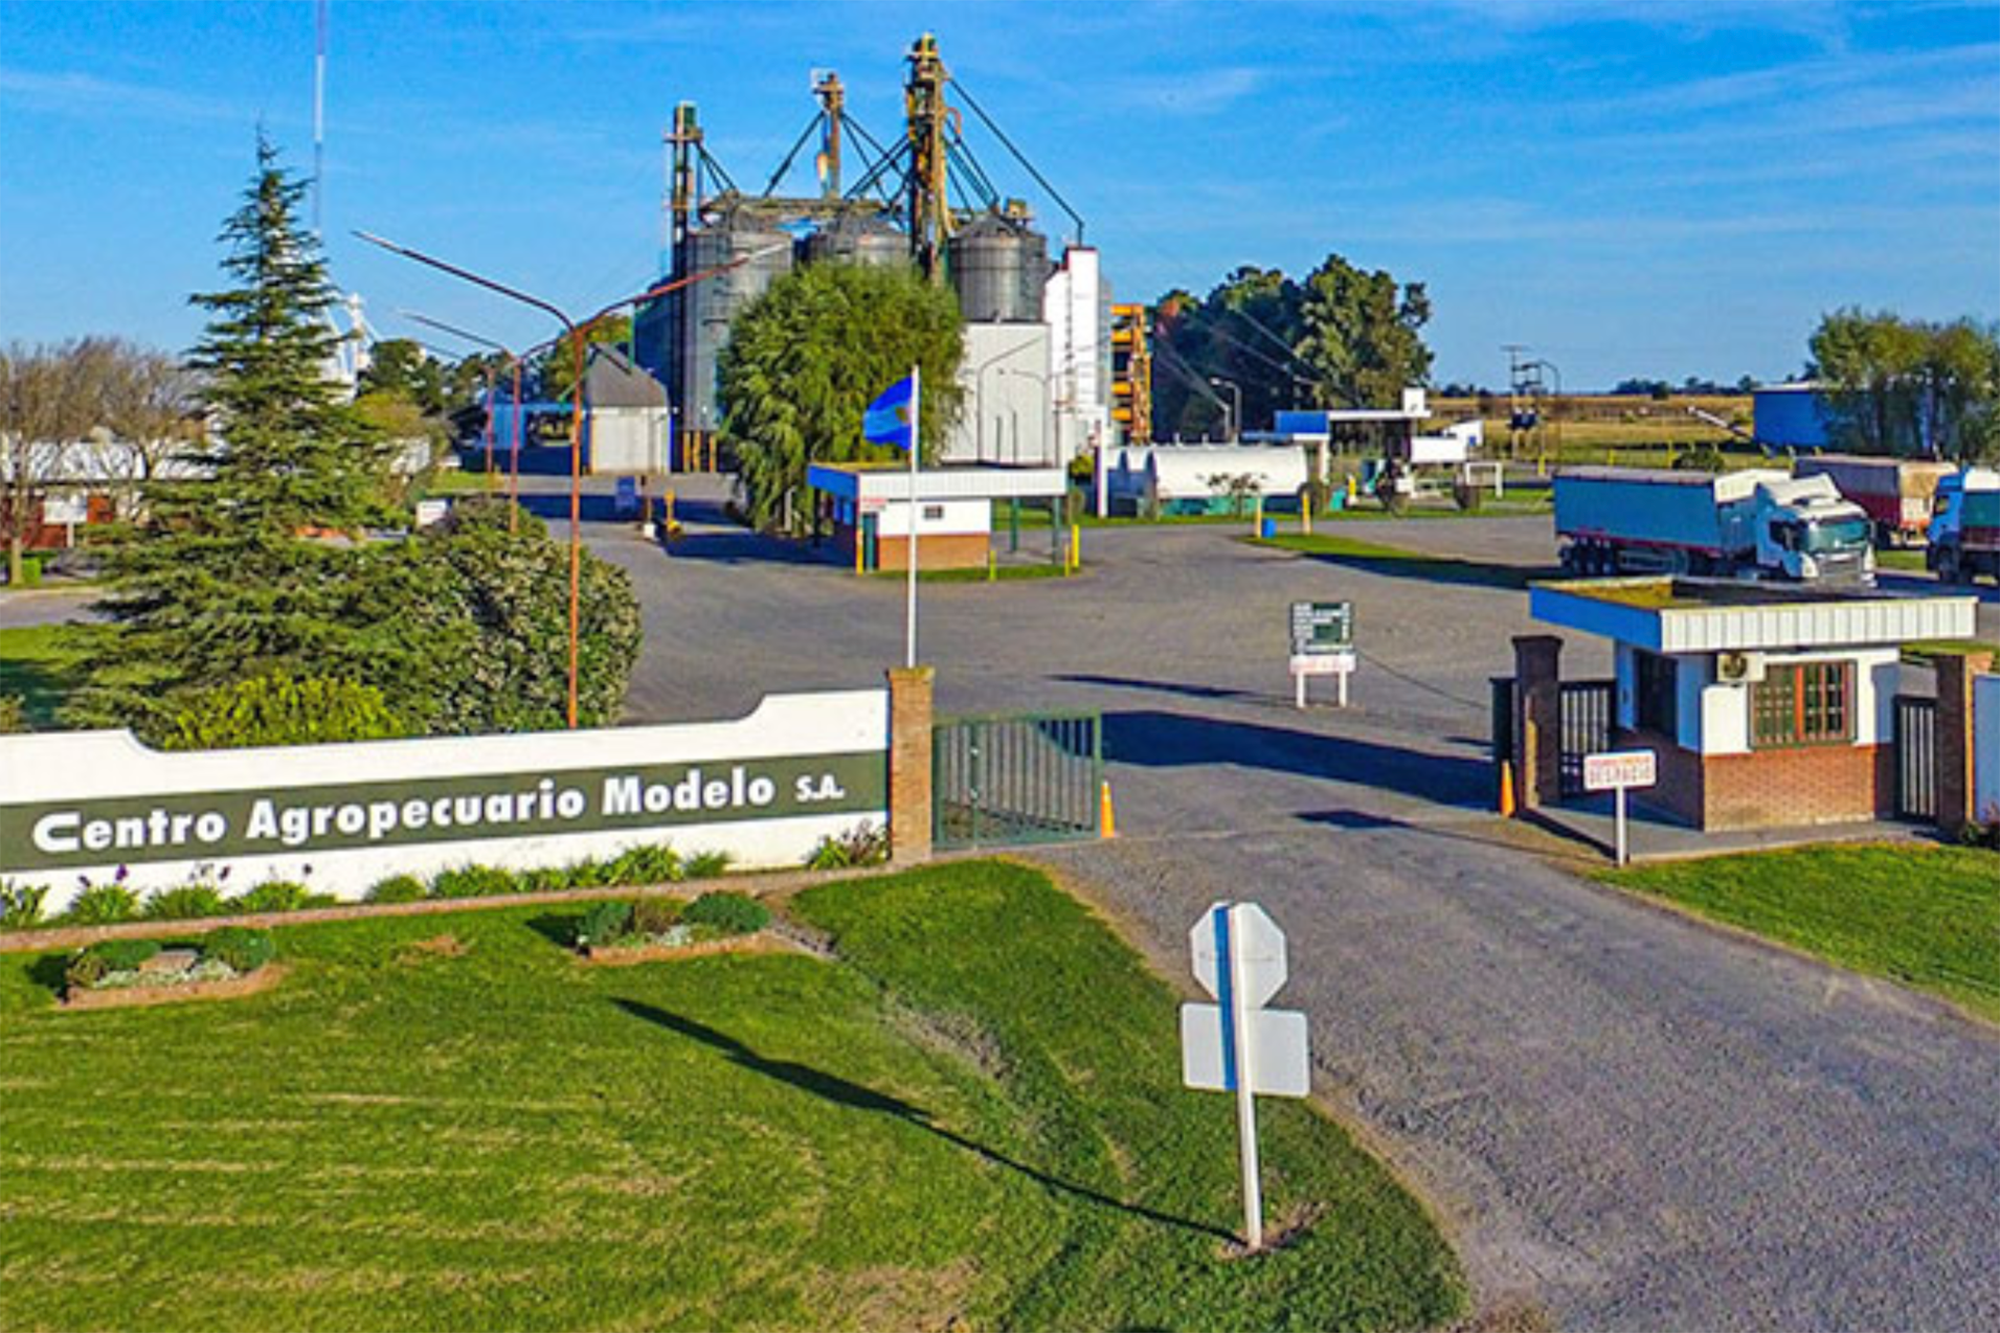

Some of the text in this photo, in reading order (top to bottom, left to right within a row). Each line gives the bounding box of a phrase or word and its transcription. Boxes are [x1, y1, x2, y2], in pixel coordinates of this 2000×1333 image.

[33, 766, 846, 852] Centro Agropecuario Modelo S.A.
